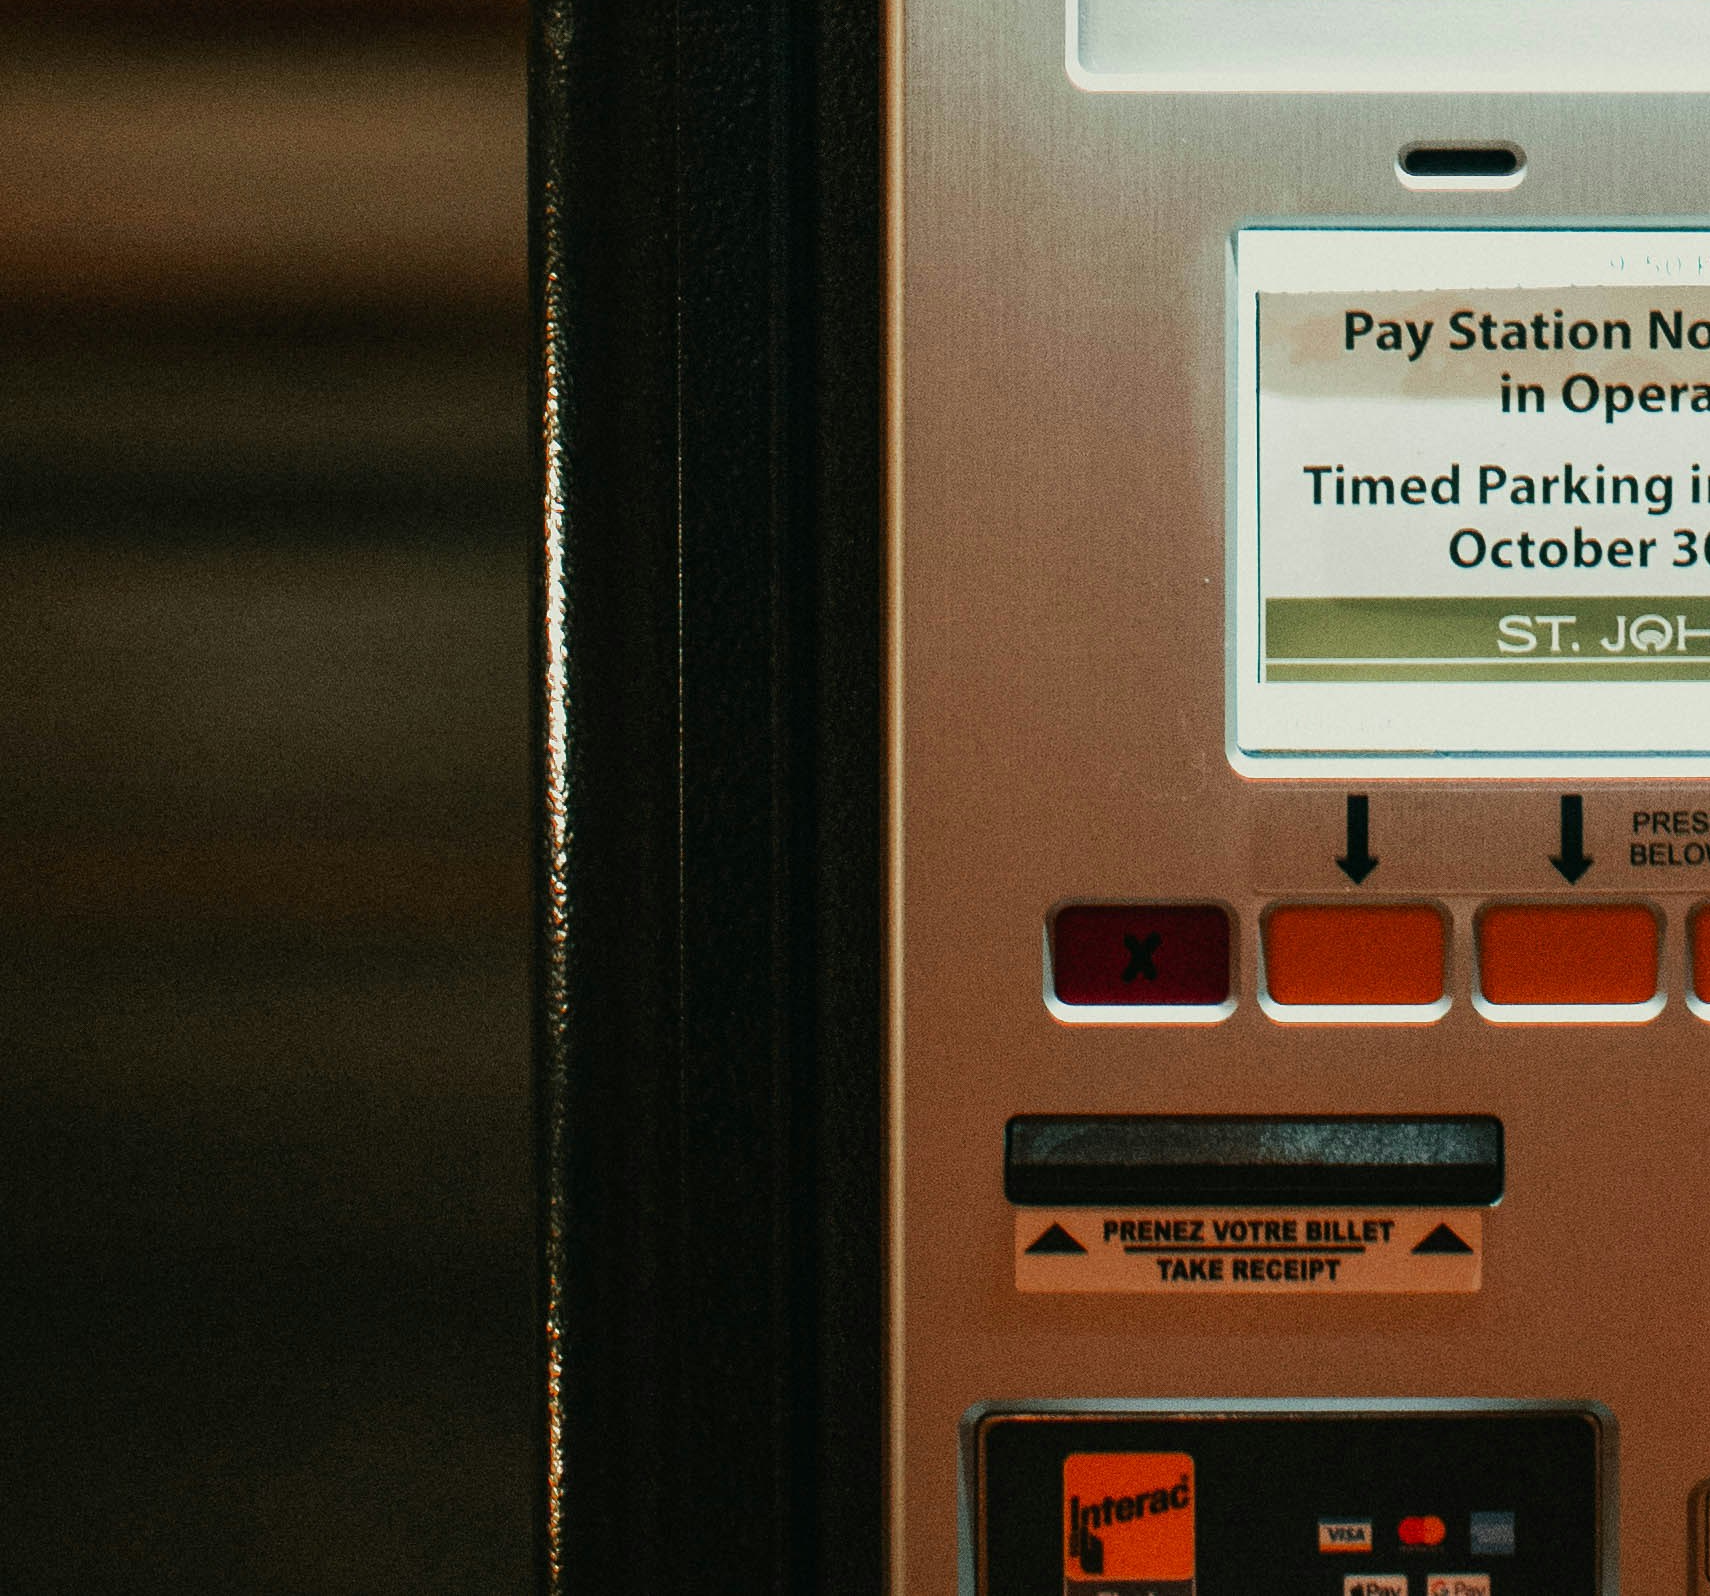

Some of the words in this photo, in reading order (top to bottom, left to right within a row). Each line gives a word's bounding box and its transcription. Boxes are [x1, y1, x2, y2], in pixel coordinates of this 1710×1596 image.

[1346, 312, 1433, 361] Pay
[1450, 310, 1630, 350] Station
[1502, 373, 1544, 412] in
[1304, 465, 1459, 505] Timed
[1480, 464, 1672, 515] Parking
[1450, 528, 1656, 568] October
[1497, 616, 1579, 653] ST.
[1104, 1221, 1203, 1242] PRENEZ
[1213, 1220, 1297, 1242] VOTRE
[1307, 1220, 1394, 1242] BILLET
[1157, 1259, 1223, 1280] TAKE
[1233, 1259, 1340, 1280] RECEIPT
[1070, 1481, 1188, 1529] Interac
[1327, 1528, 1366, 1542] VISA
